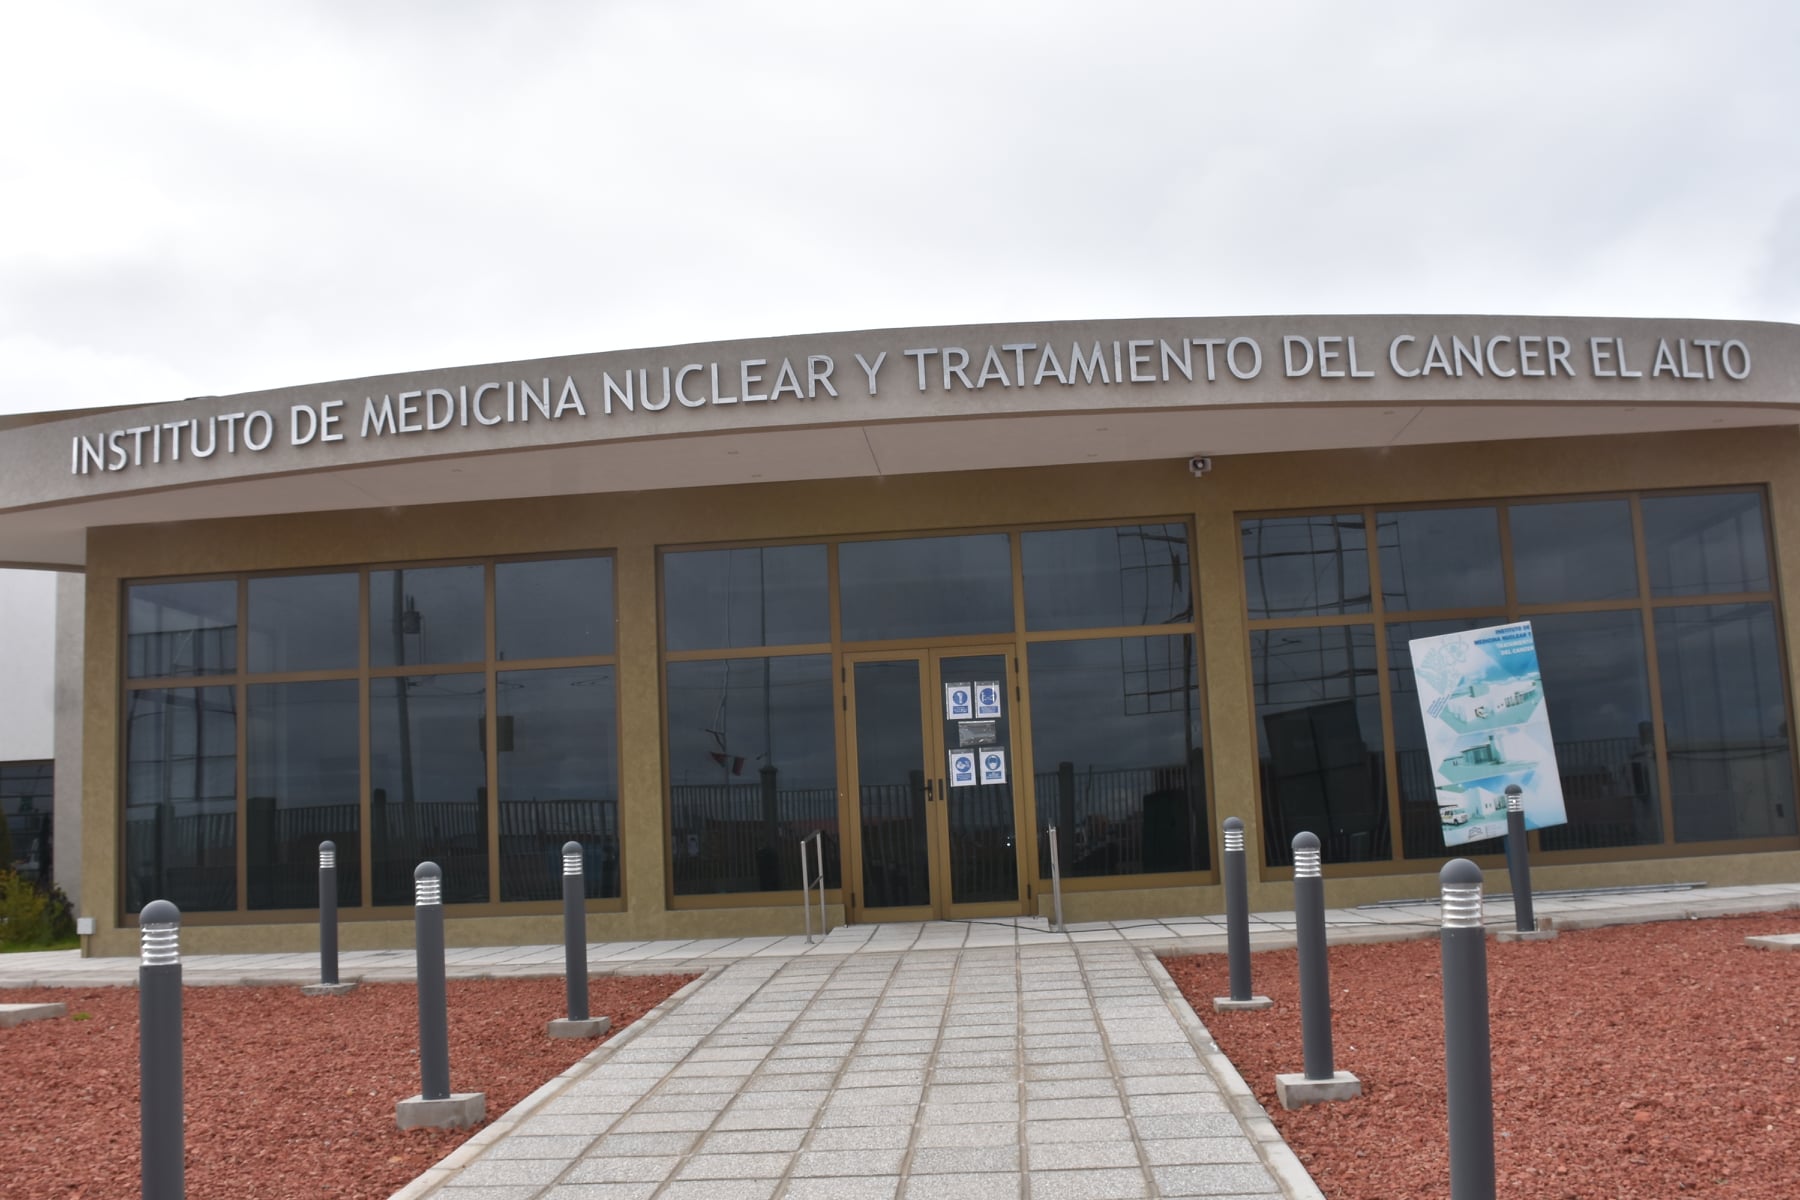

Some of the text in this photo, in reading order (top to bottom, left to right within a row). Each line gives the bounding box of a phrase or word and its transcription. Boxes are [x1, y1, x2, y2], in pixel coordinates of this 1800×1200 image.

[71, 334, 1752, 475] INSTITUTO DE MEDICINA NUCLEAR Y TRATAMIENTO DEL CANCER EL ALTO
